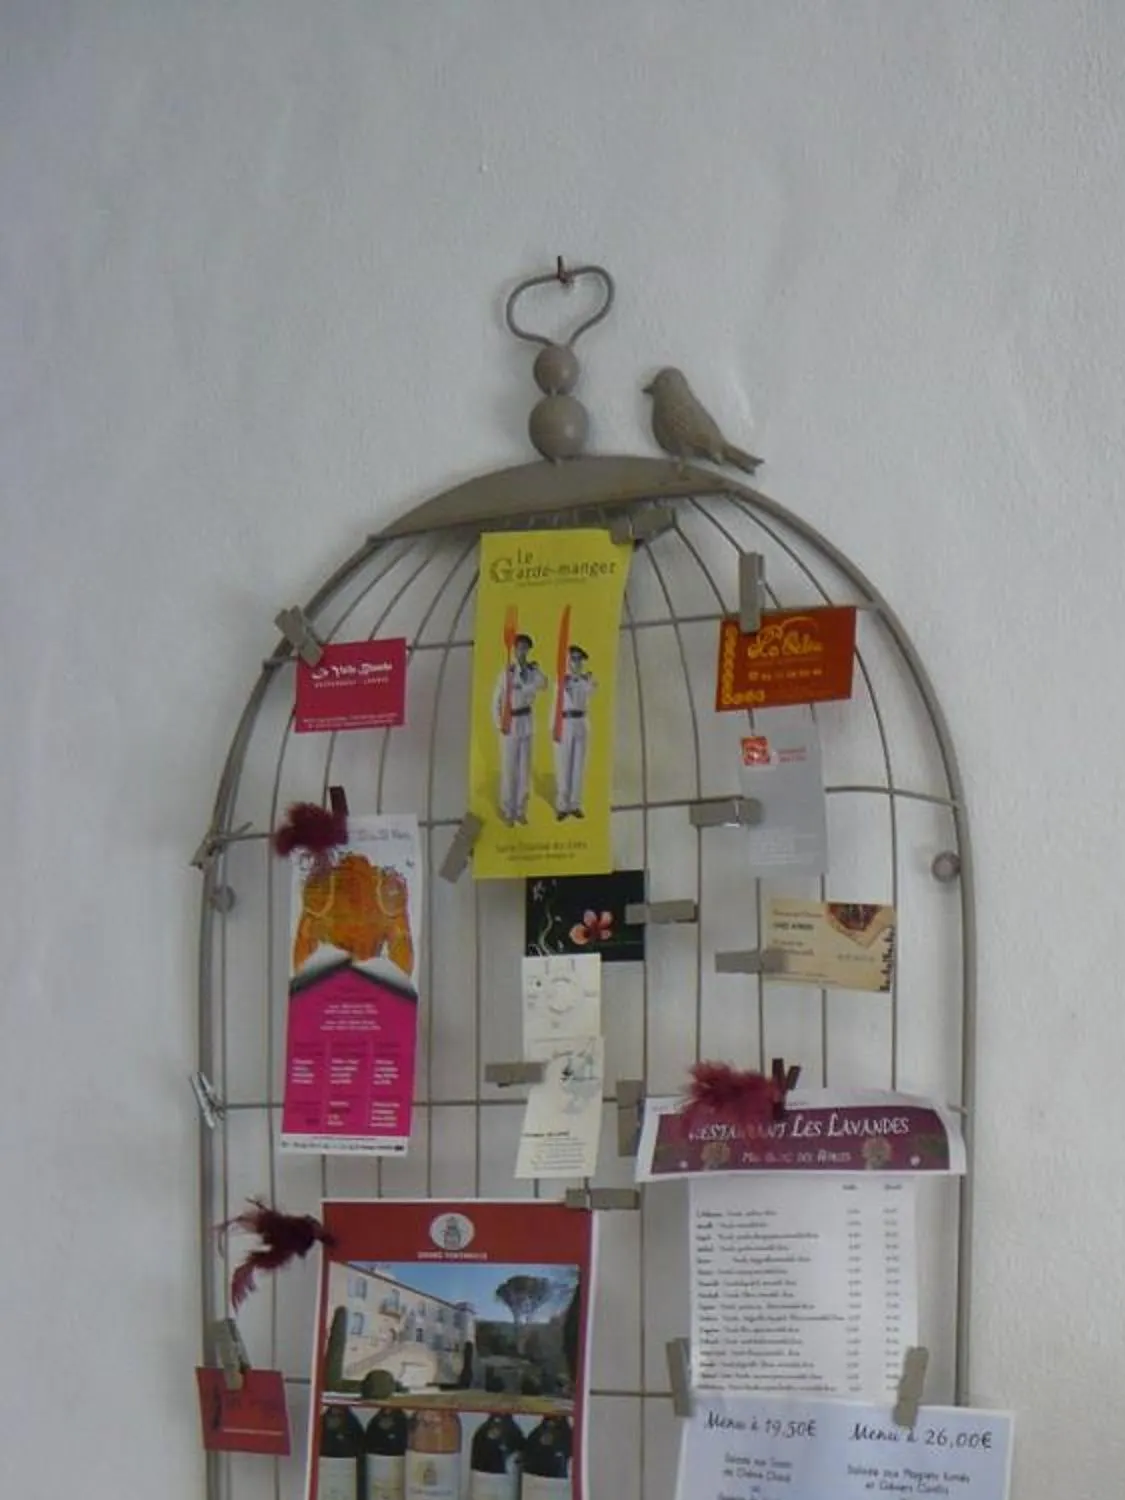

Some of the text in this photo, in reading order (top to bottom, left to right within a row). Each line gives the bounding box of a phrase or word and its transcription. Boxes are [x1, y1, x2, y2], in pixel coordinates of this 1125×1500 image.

[704, 1409, 747, 1431] Menu
[847, 1422, 900, 1442] Menu
[924, 1429, 993, 1450] 26,00€
